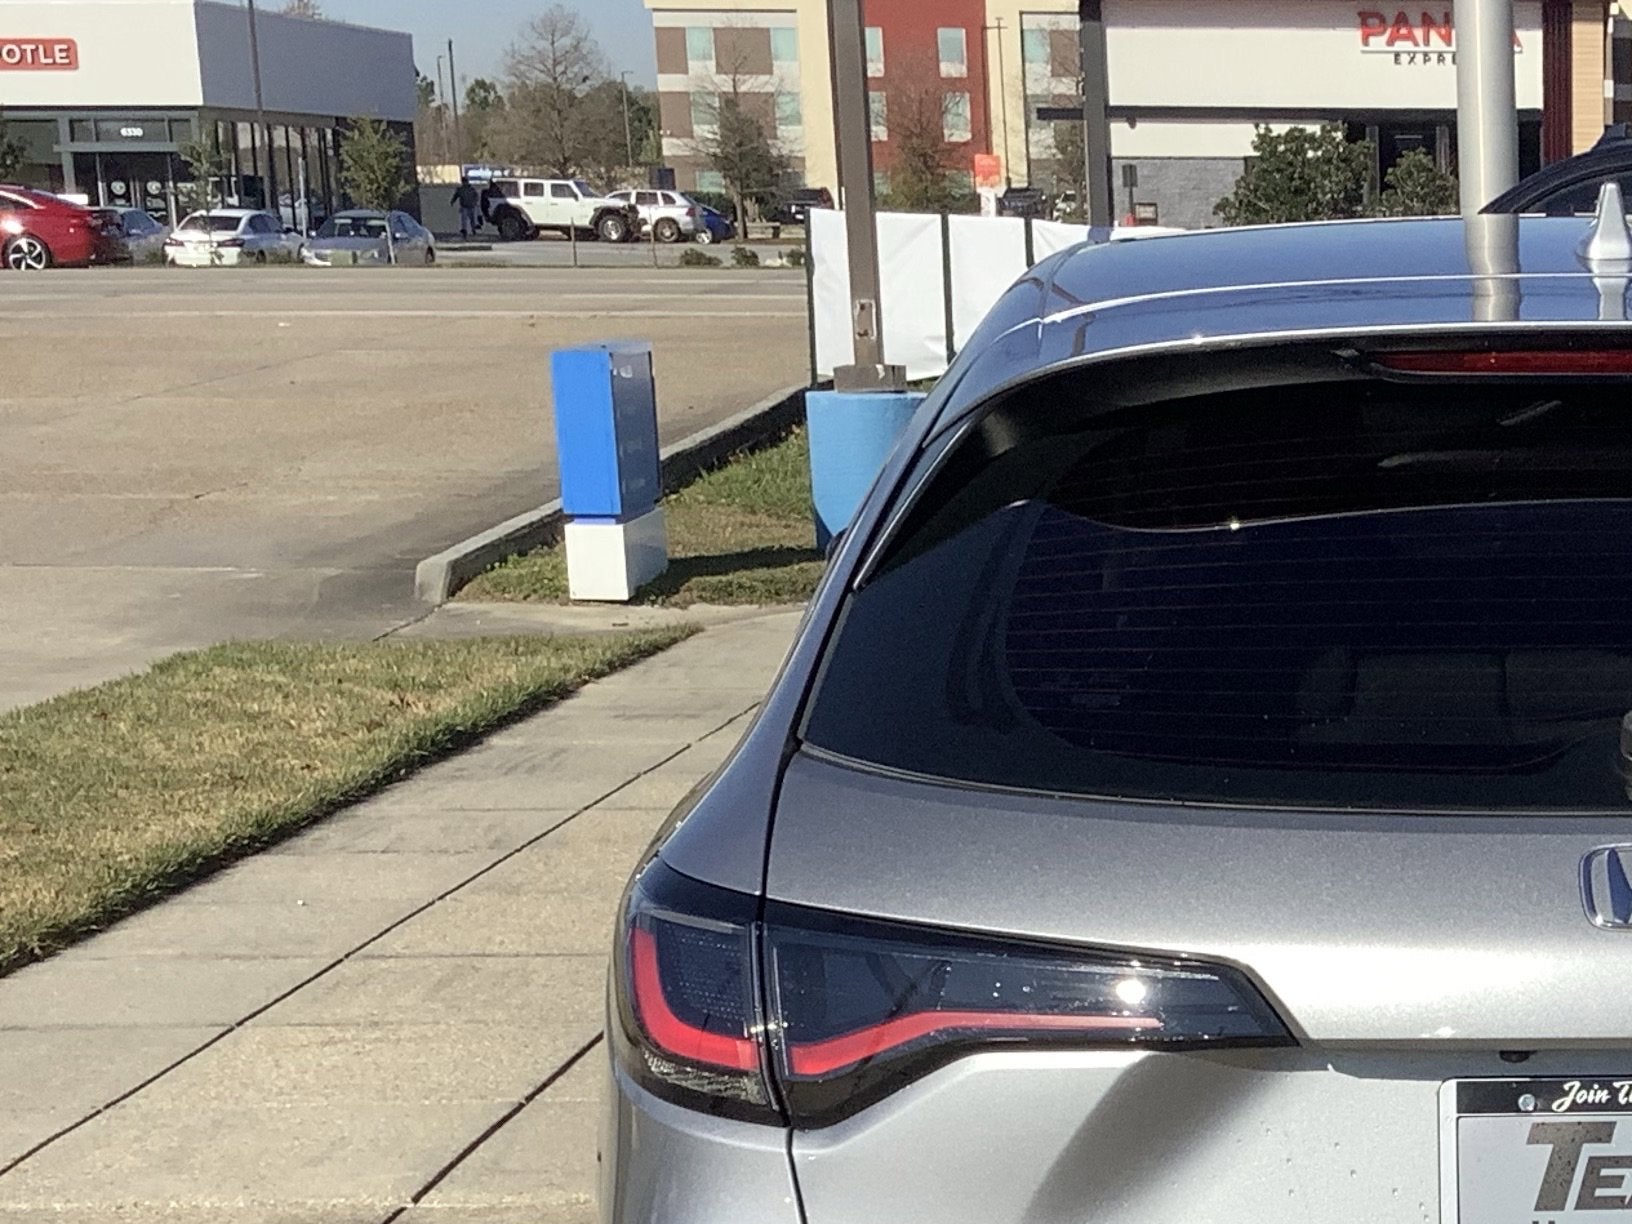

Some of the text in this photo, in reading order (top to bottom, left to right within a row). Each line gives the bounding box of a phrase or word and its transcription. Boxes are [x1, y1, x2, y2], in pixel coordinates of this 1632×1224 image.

[0, 43, 71, 64] OTLE
[1393, 52, 1457, 66] EXPRE
[1552, 1081, 1612, 1113] Join
